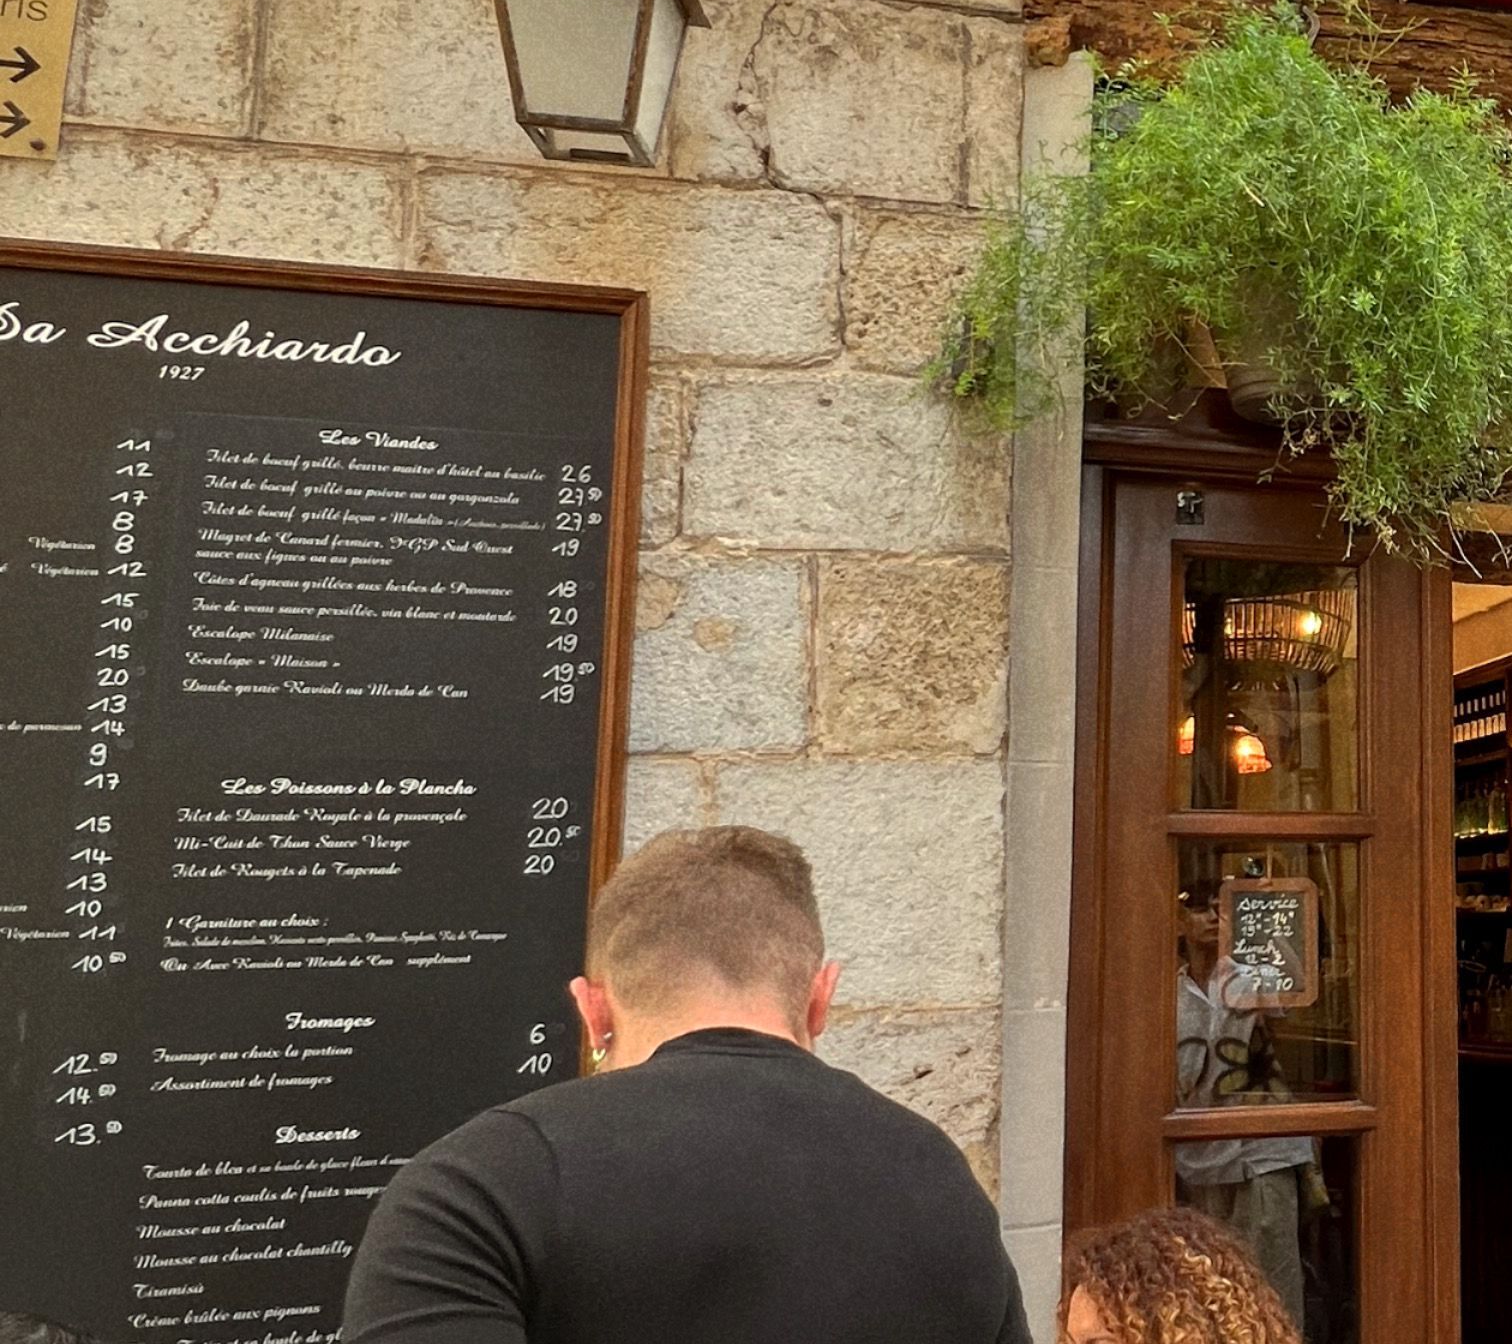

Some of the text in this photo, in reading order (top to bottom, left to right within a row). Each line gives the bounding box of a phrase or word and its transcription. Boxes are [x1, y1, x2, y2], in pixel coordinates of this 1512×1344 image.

[87, 314, 402, 367] Acchiardo
[158, 365, 205, 381] 1927
[117, 439, 151, 452] 11
[319, 429, 439, 451] Les Viandes
[116, 462, 154, 477] 12
[562, 464, 592, 483] 26
[109, 490, 149, 506] 17
[112, 511, 135, 531] 8
[114, 534, 135, 554] 8
[552, 538, 580, 556] 19
[107, 562, 147, 577] 12
[547, 580, 578, 598] 18
[101, 593, 140, 608] 15
[100, 617, 133, 632] 10
[548, 606, 578, 626] 20
[94, 644, 131, 660] 15
[546, 633, 578, 653] 19
[97, 668, 129, 687] 20
[540, 683, 575, 704] 19
[87, 694, 127, 714] 13
[90, 720, 125, 737] 14
[89, 743, 108, 766] 9
[83, 773, 120, 791] 17
[221, 777, 478, 795] Les Poissons à la Plancha
[532, 796, 569, 820] 20
[75, 815, 112, 833] 15
[70, 848, 113, 865] 14
[523, 855, 555, 875] 20
[66, 872, 108, 892] 13
[64, 900, 102, 917] 10
[285, 1011, 377, 1033] Fromages
[530, 1023, 546, 1045] 6
[517, 1054, 552, 1075] 10
[274, 1124, 362, 1144] Desserts
